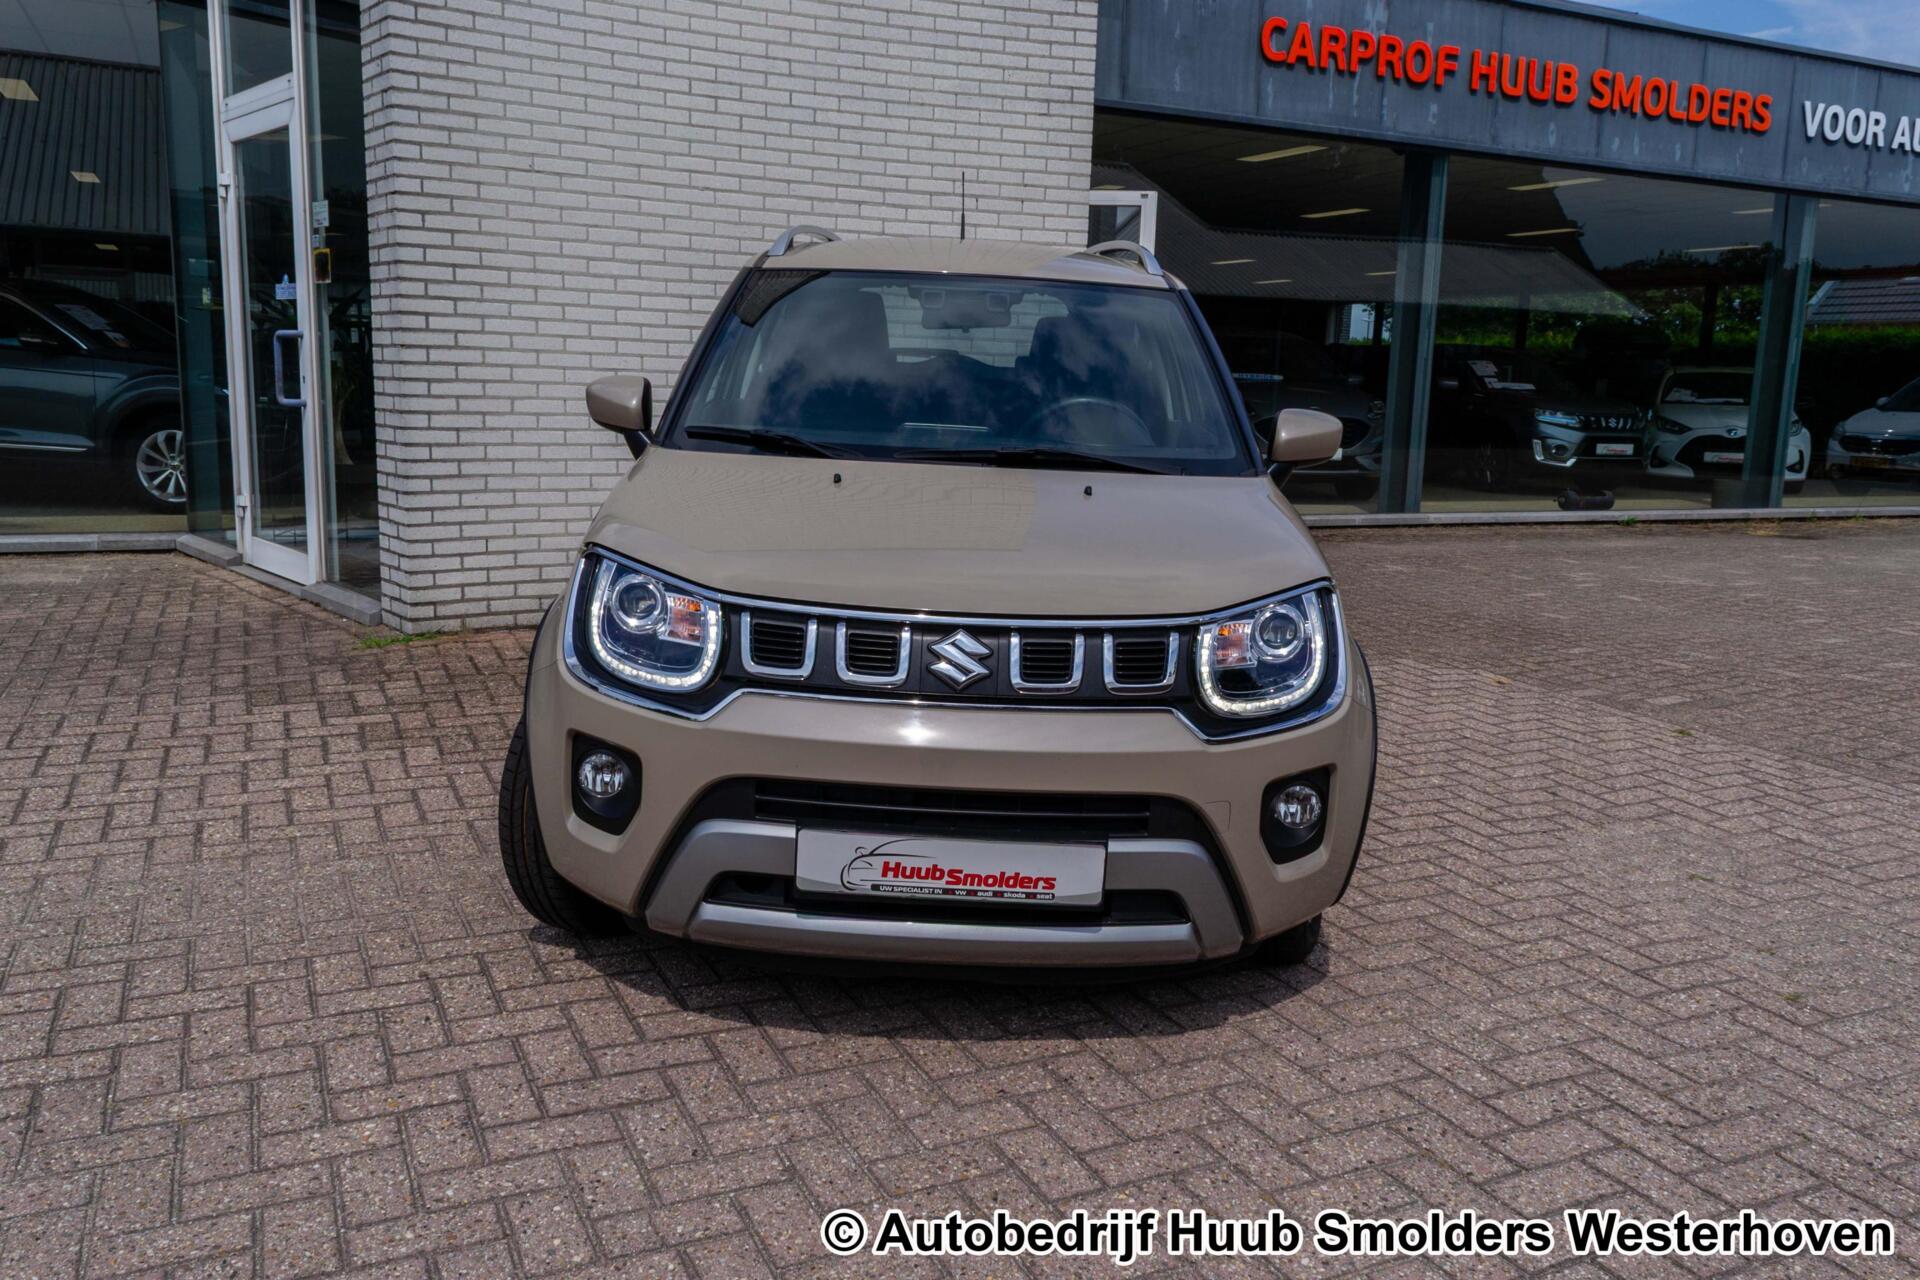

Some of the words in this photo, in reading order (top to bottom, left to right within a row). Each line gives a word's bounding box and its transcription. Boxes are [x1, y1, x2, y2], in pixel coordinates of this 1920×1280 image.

[1260, 16, 1460, 86] CARPROF
[1471, 48, 1579, 104] HUUB
[1589, 68, 1773, 132] SMOLDERS
[1804, 100, 1886, 147] VOOR
[893, 886, 934, 894] SPECIALIST
